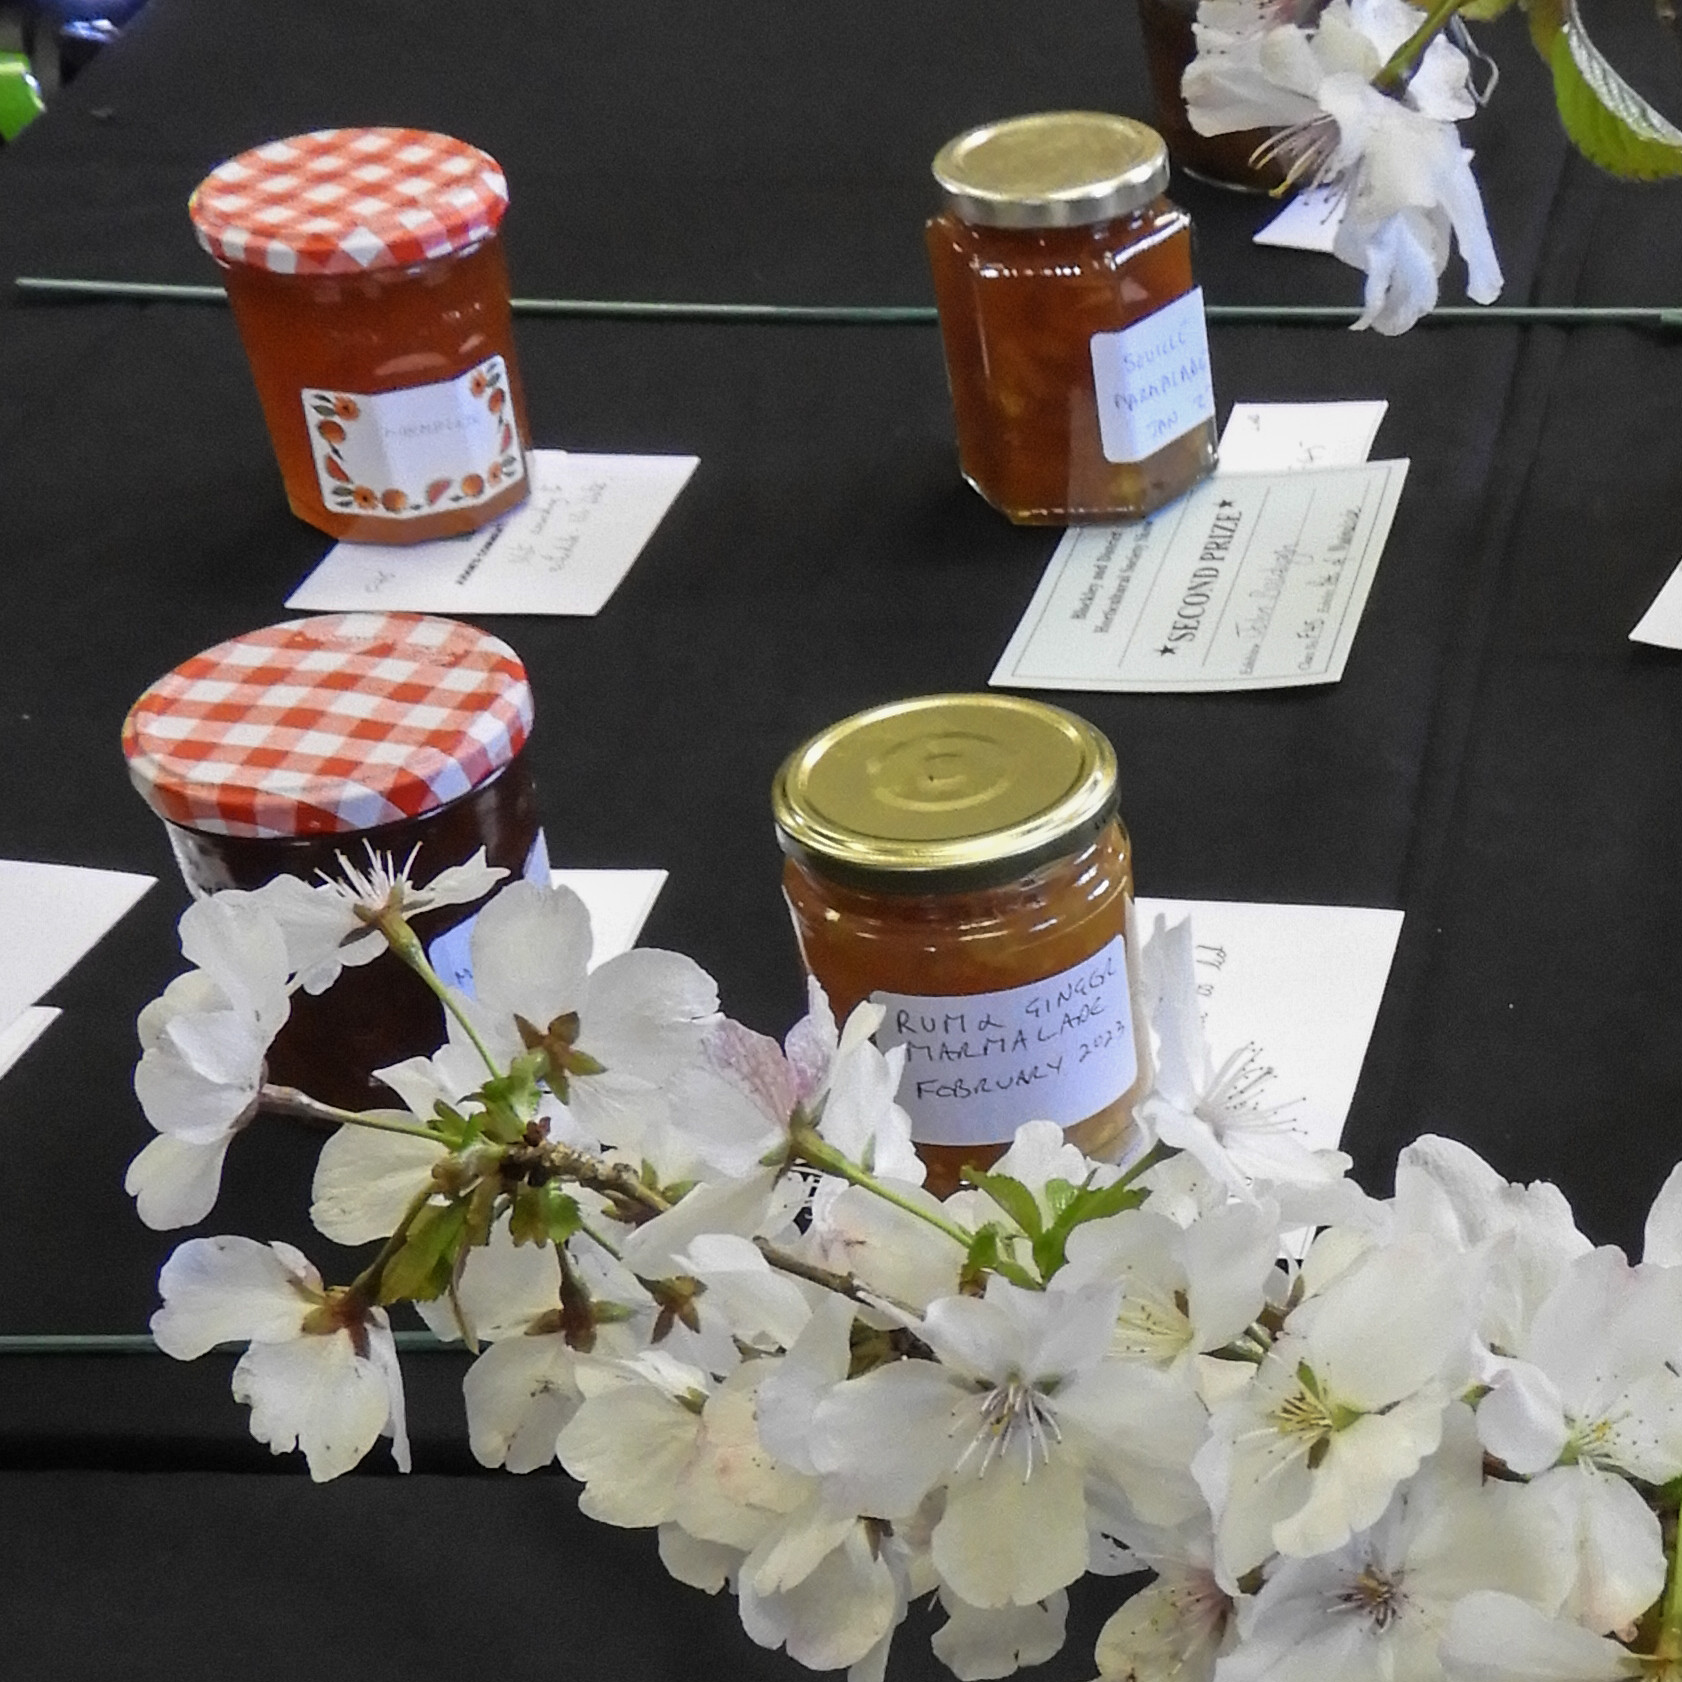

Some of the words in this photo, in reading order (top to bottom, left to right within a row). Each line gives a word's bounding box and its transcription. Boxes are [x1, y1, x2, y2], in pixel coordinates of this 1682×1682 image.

[1167, 567, 1220, 642] SECOND
[1199, 510, 1242, 561] PRIZE
[896, 1009, 966, 1035] RUM
[905, 996, 1106, 1063] MARMALADE
[1078, 1019, 1127, 1064] 2023
